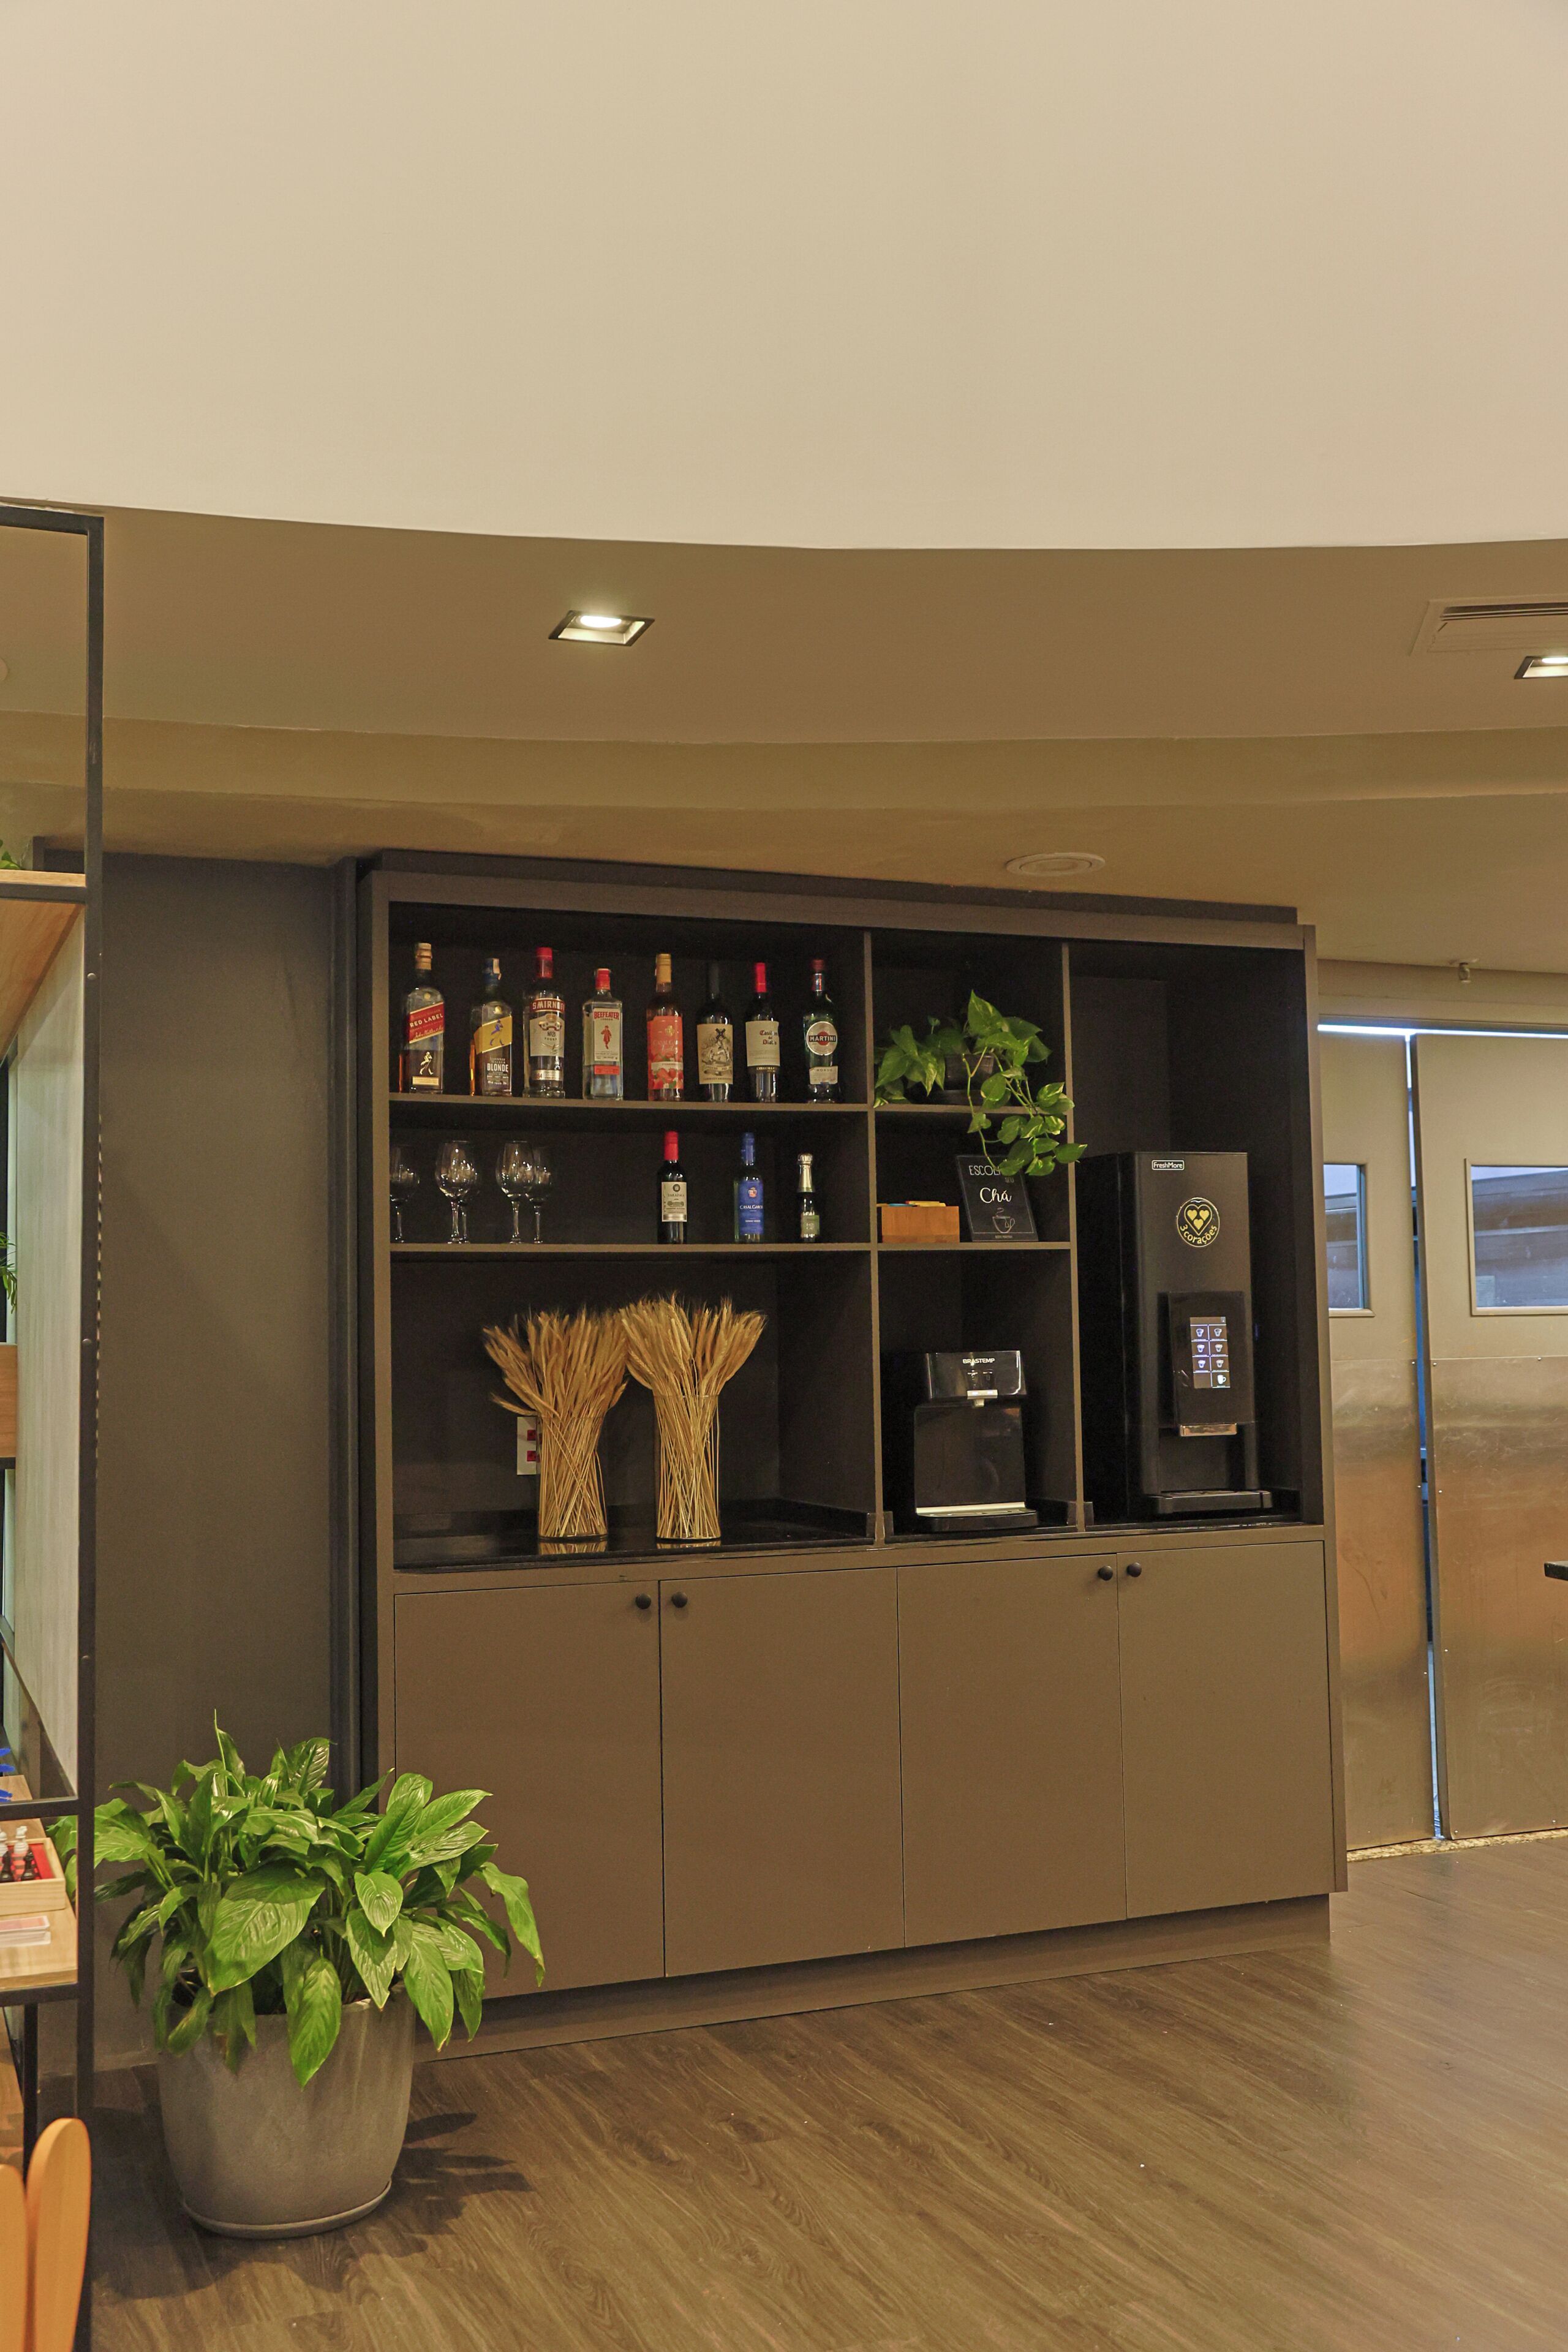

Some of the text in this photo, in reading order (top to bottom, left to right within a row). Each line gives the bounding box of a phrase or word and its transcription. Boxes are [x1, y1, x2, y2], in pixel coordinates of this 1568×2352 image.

[409, 1019, 423, 1028] RED
[424, 1013, 443, 1023] LABEL
[594, 1011, 619, 1020] BEEFEATER
[487, 1063, 509, 1072] BLONDE
[979, 1187, 1012, 1204] Chá
[1183, 1226, 1217, 1244] corações
